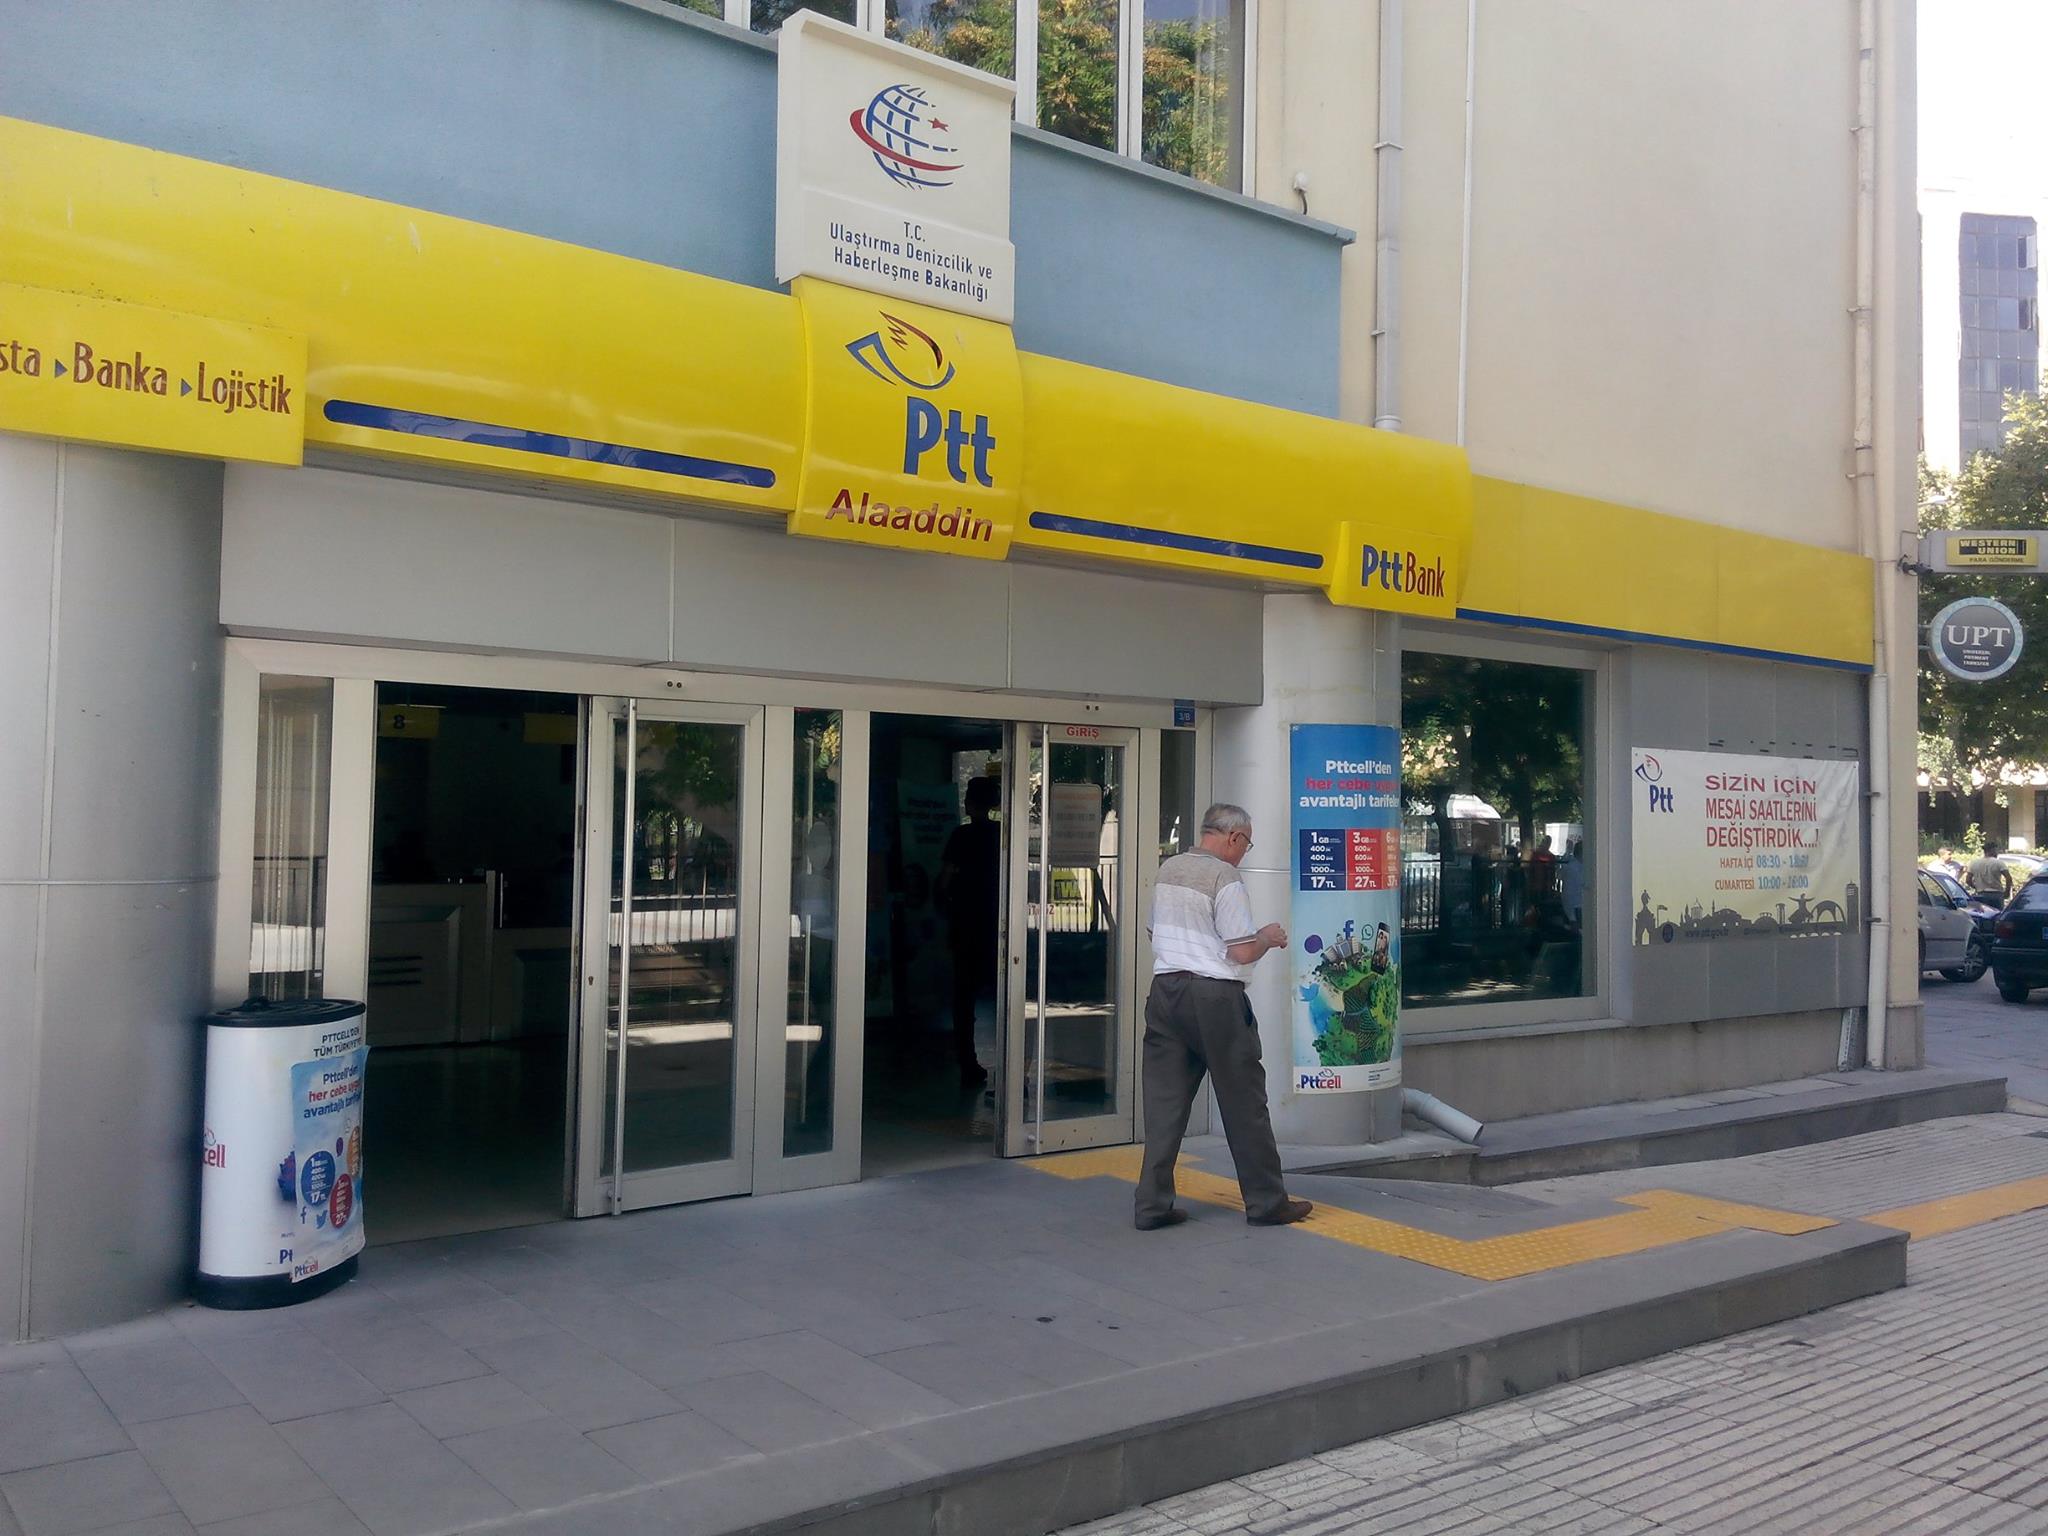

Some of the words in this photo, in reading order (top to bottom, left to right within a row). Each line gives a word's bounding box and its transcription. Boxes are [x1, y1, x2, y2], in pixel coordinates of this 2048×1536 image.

[903, 221, 926, 242] T.C.
[829, 222, 900, 255] Ulaştırma
[906, 242, 973, 275] Denizcilik
[978, 264, 993, 280] ve
[834, 246, 919, 282] Haberleşme
[925, 270, 988, 302] Bakanlığı
[73, 341, 168, 396] Banka
[197, 361, 292, 415] Lojistik
[903, 395, 996, 488] Ptt
[824, 488, 994, 542] Alaaddin
[1959, 539, 2016, 547] WESTERN
[1946, 625, 2011, 647] UPT
[393, 714, 406, 730] 8
[1705, 772, 1766, 793] SİZİN
[1774, 775, 1816, 798] İÇİN
[1300, 794, 1366, 810] avantajlı
[1649, 784, 1674, 813] Ptt
[1705, 794, 1746, 819] MESAİ
[1749, 797, 1817, 822] SAATLERİNİ
[1720, 857, 1743, 868] HAFTA
[1756, 854, 1781, 869] 08:30
[1715, 877, 1755, 890] CUMARTESİ
[313, 1046, 333, 1058] TÜM
[1300, 1074, 1342, 1089] Pttcell
[308, 1090, 328, 1102] her
